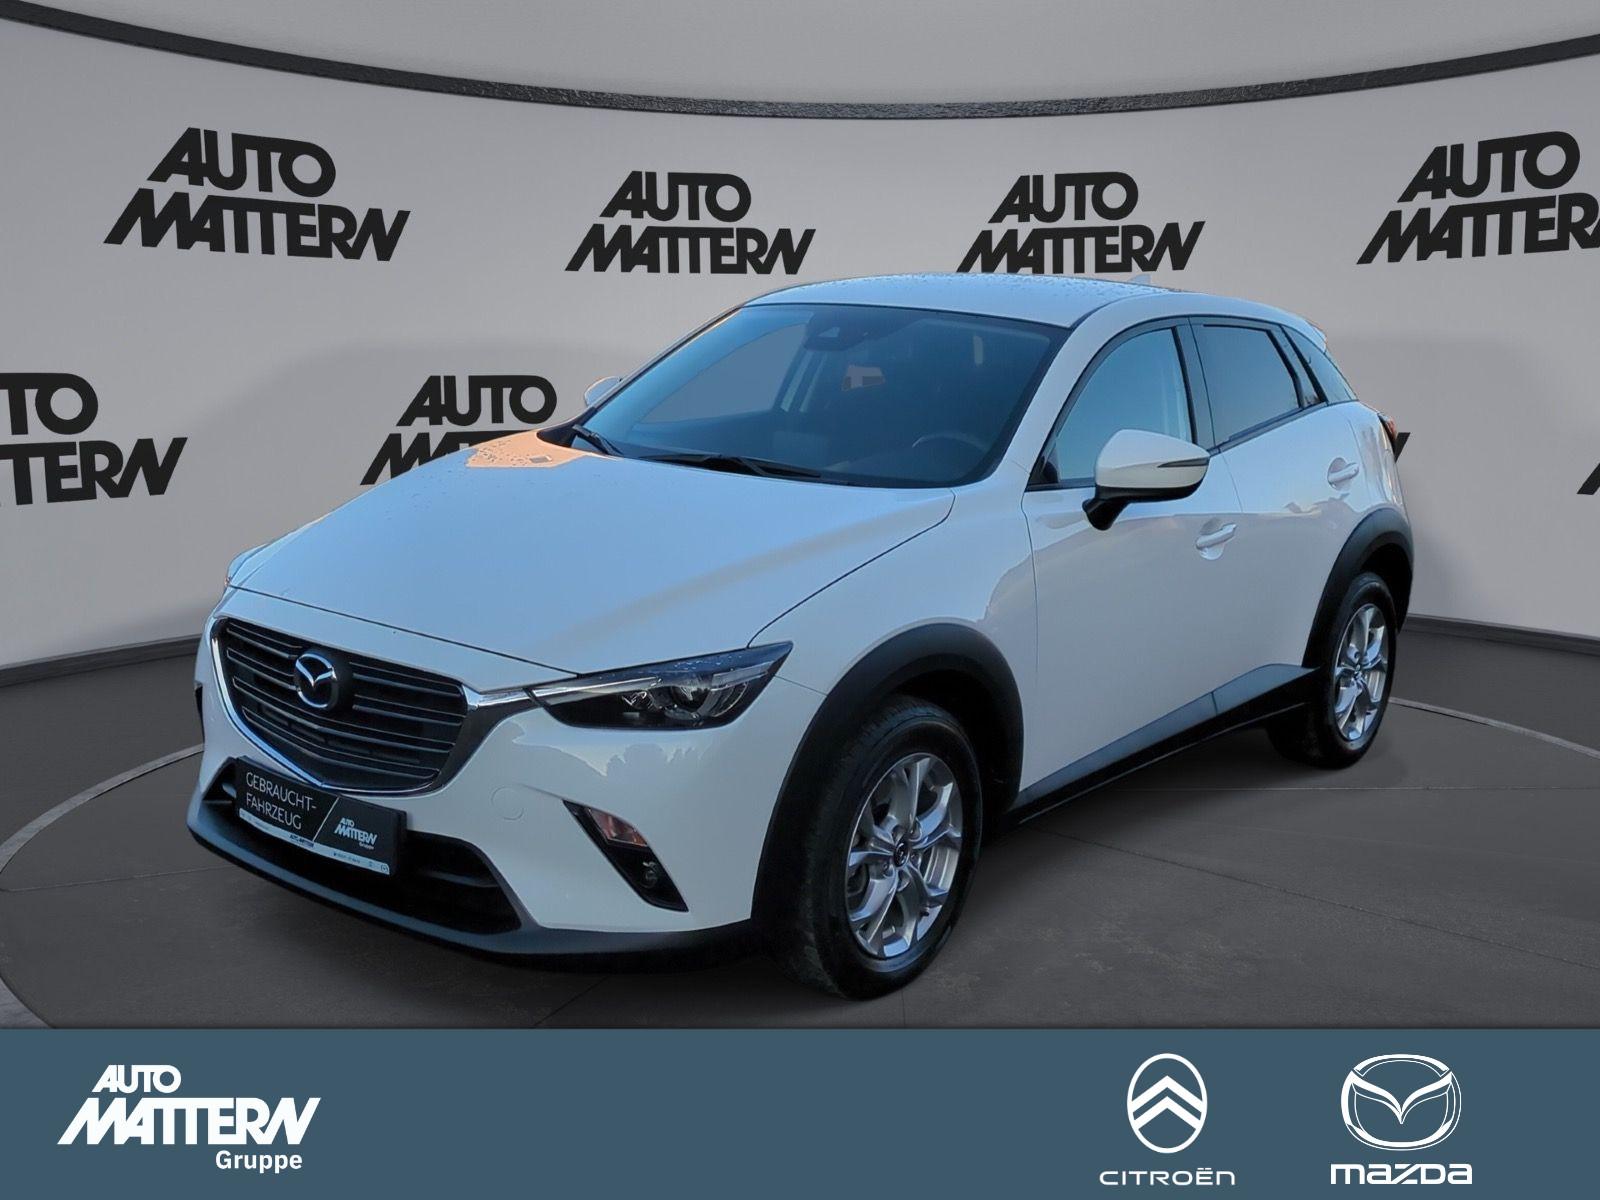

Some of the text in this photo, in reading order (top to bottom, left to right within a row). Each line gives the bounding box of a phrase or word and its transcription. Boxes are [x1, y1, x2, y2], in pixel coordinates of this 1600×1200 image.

[147, 128, 336, 197] AUTO
[1398, 132, 1580, 202] AUTO
[600, 171, 751, 222] AUTO
[988, 172, 1138, 223] AUTO
[104, 188, 410, 261] MATTERN
[565, 224, 815, 274] MATTERN
[957, 221, 1205, 274] MATTERN
[1357, 193, 1600, 264] MATTER
[397, 375, 557, 426] AUTO
[246, 771, 317, 811] GEBRAUCHT-
[246, 792, 302, 830] FAHRZEUG
[334, 823, 378, 845] MATTERN
[339, 817, 355, 828] AUTO
